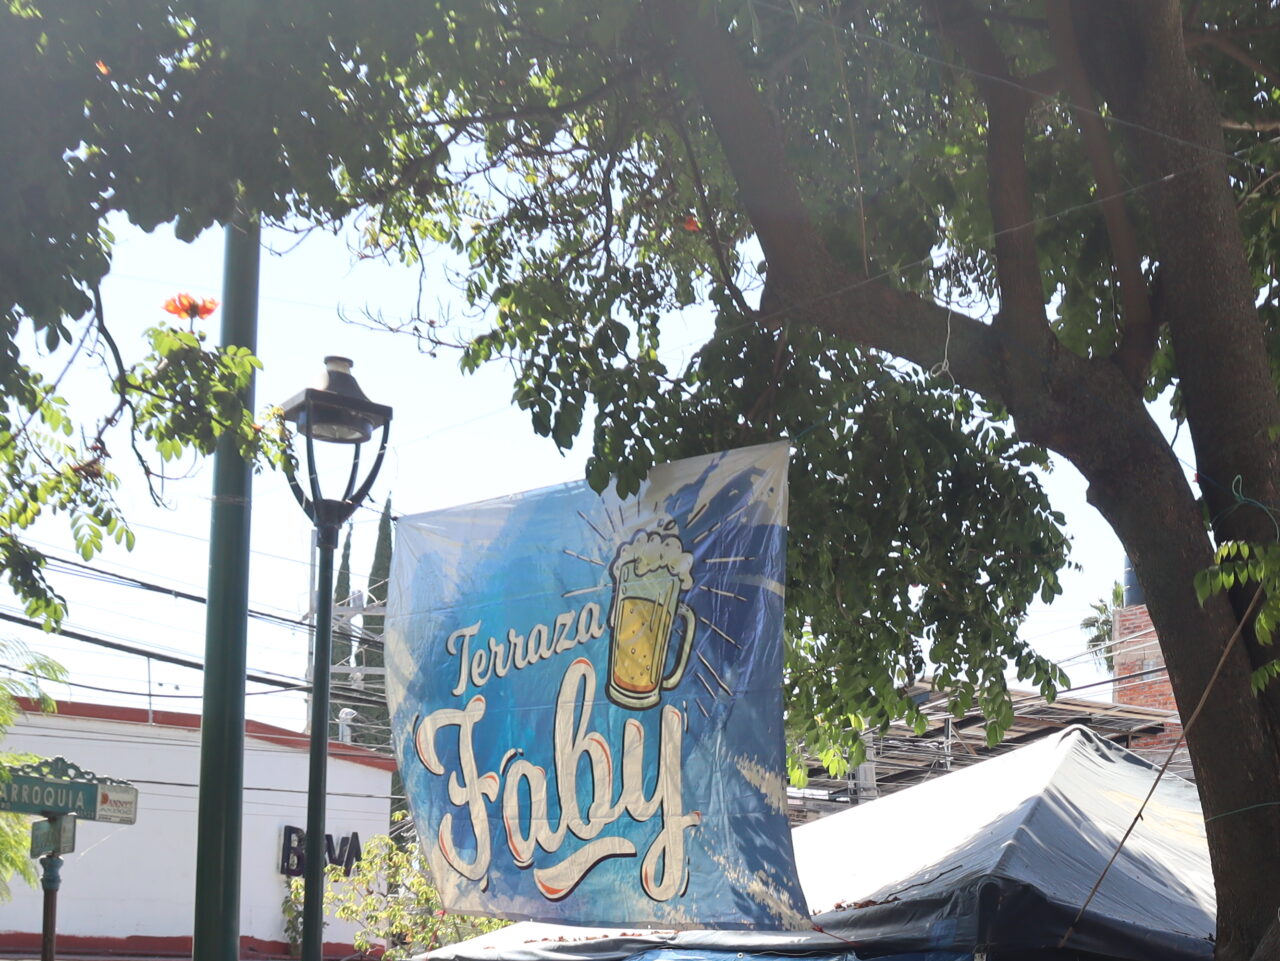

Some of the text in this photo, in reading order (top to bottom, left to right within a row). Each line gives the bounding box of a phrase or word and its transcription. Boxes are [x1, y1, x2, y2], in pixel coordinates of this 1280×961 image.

[446, 601, 606, 697] Terraza
[413, 656, 701, 902] Faby
[280, 825, 363, 877] BVA
